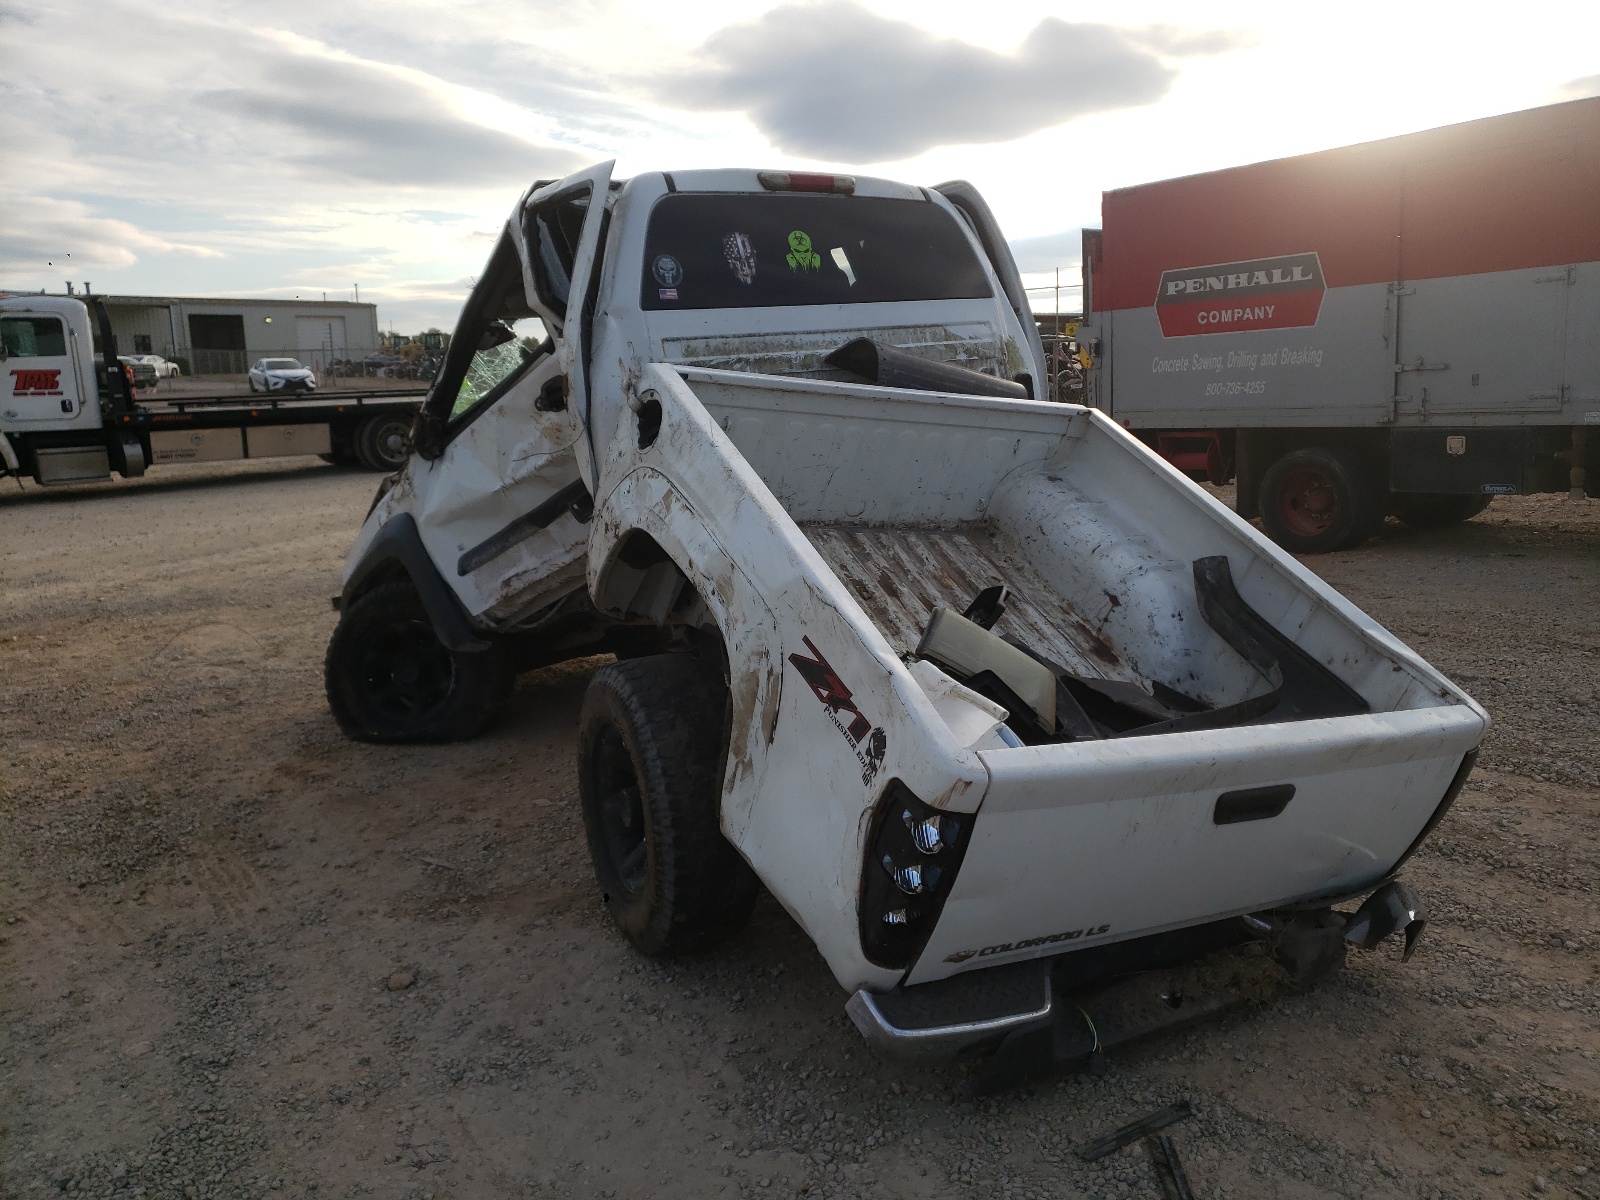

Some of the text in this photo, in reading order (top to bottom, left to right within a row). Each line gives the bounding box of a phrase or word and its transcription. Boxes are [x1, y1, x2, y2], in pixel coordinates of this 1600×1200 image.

[1166, 266, 1313, 295] PENHALL
[1197, 305, 1275, 324] COMPANY
[1152, 354, 1189, 373] Concrete
[1227, 350, 1257, 371] Drilling
[1260, 349, 1278, 367] and
[1281, 346, 1324, 367] Breaking
[1205, 380, 1266, 396] 800-736-4255
[823, 706, 857, 752] PUNISHER
[978, 924, 1111, 957] COLORADO LS
